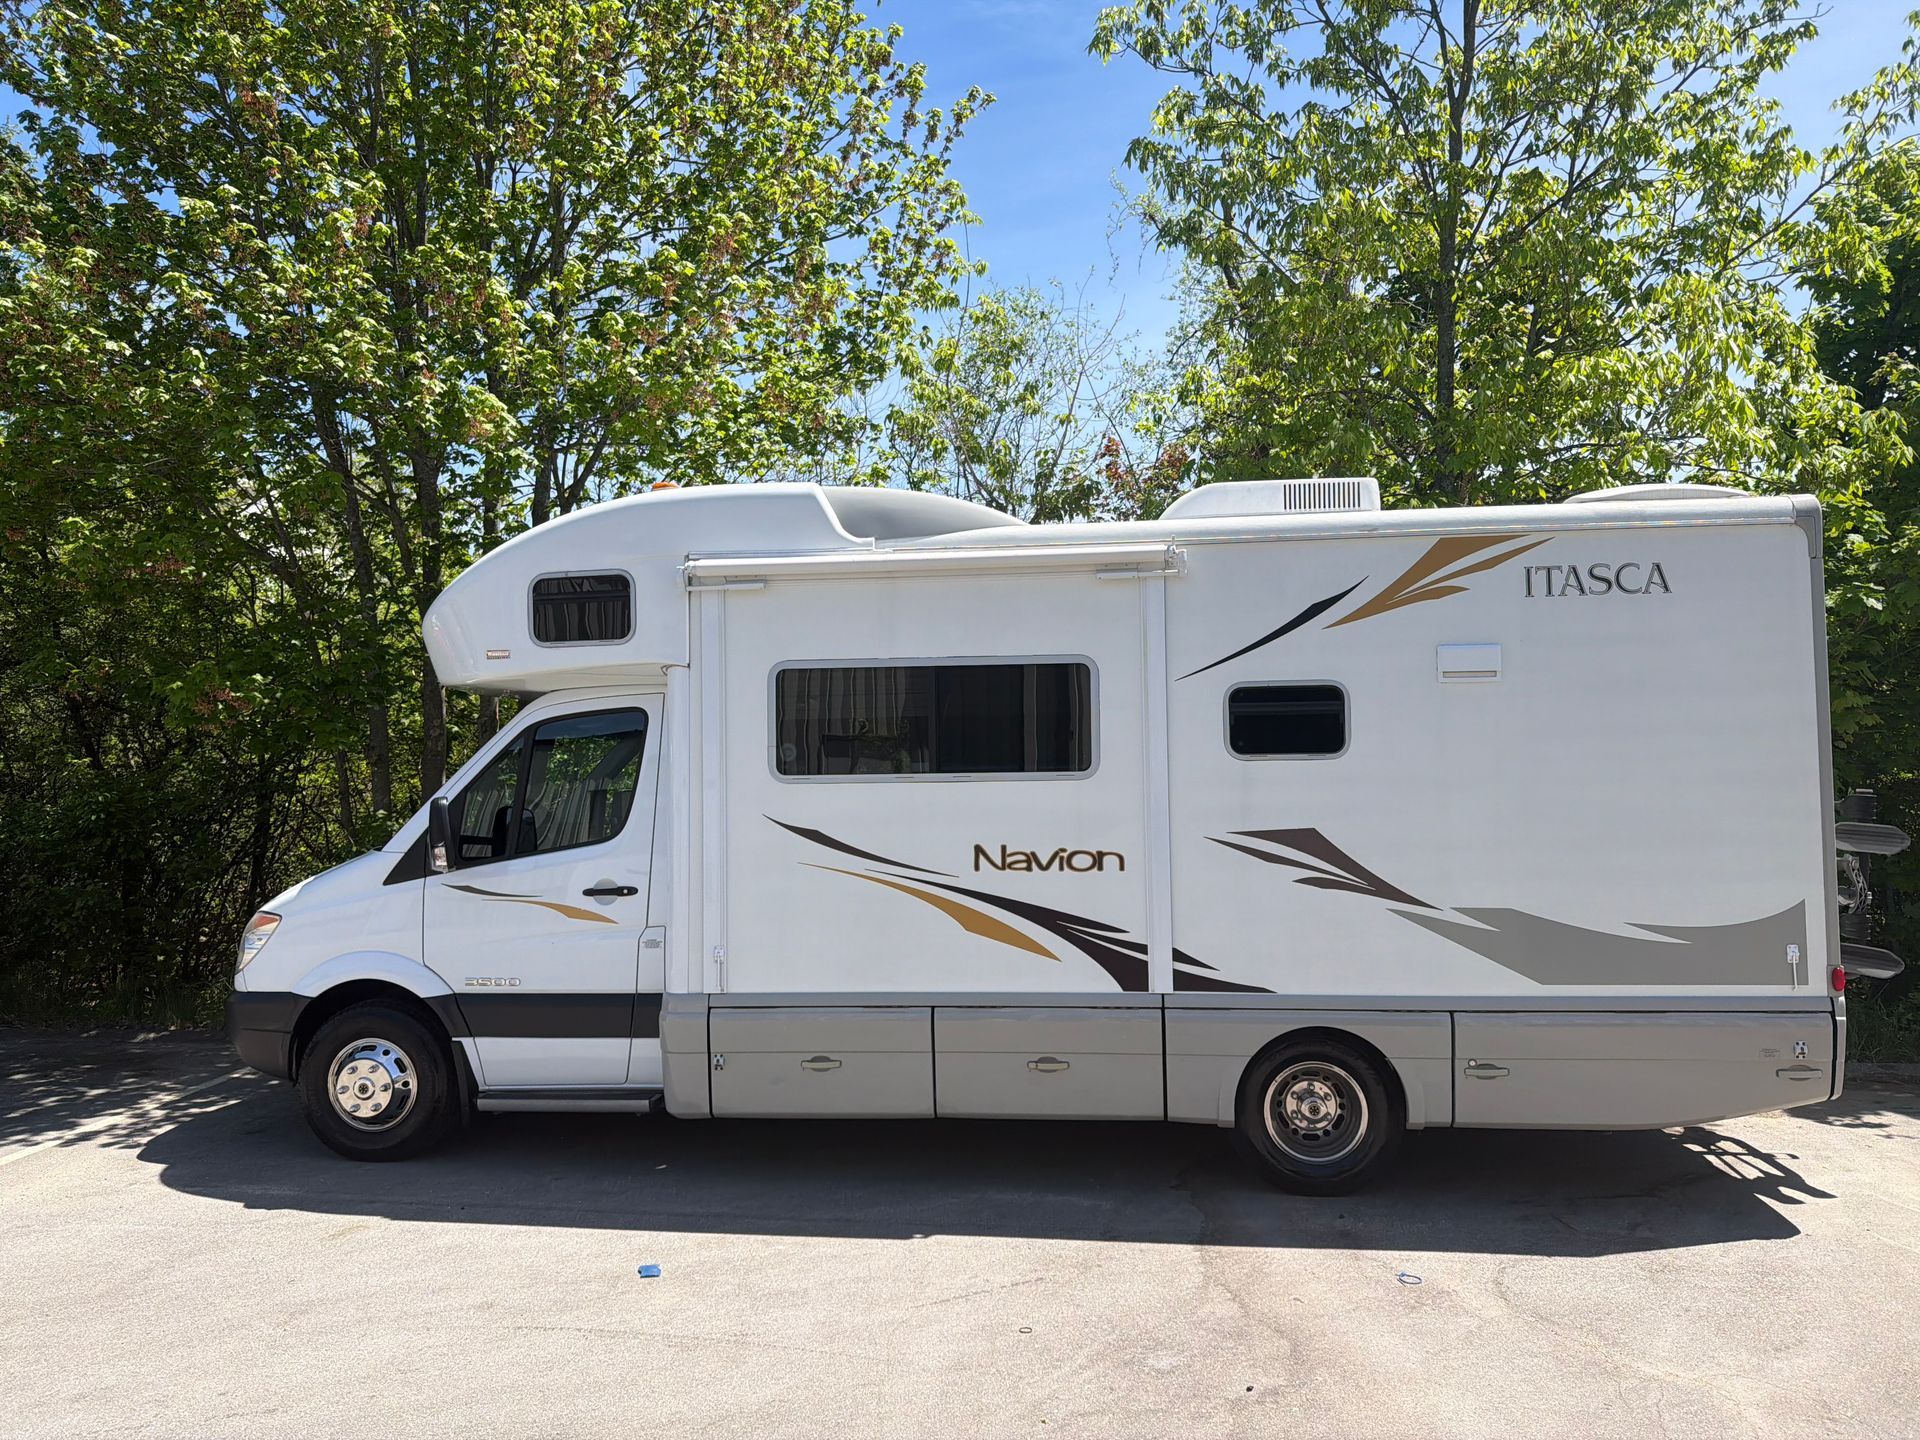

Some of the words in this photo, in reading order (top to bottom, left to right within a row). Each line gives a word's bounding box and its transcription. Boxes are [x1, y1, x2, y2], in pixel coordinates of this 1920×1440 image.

[1523, 562, 1673, 597] ITASCA
[973, 844, 1125, 872] Navion
[464, 977, 521, 987] 3500
